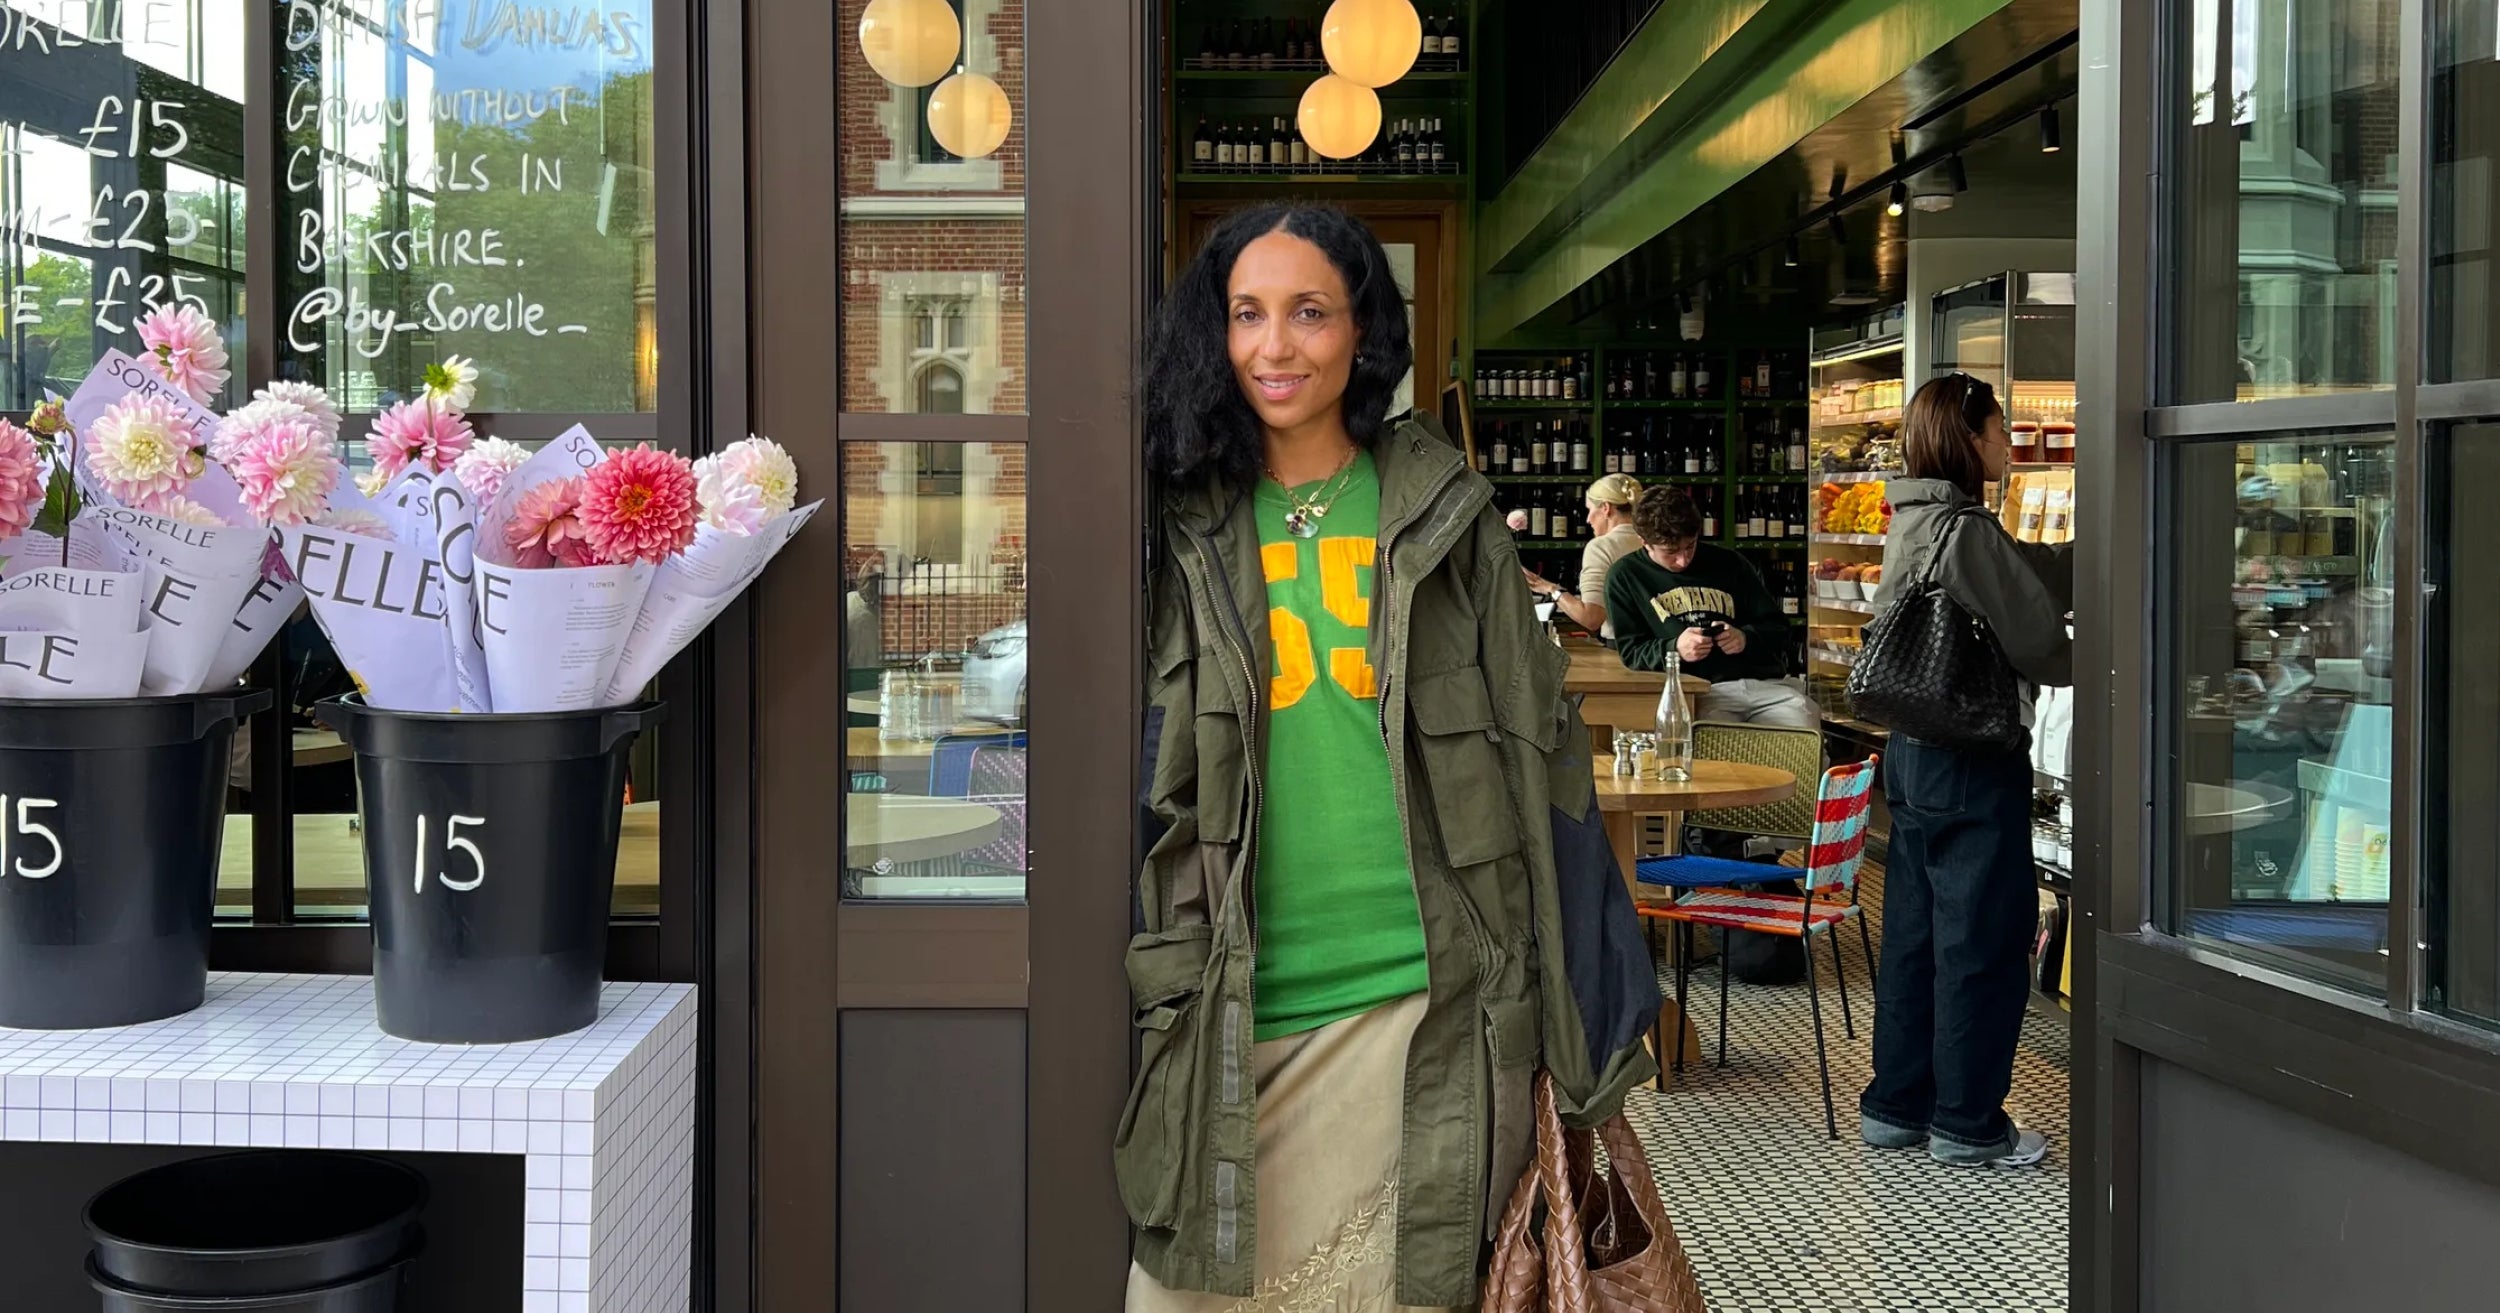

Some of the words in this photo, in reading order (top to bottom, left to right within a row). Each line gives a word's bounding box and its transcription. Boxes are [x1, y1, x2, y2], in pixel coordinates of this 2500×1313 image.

[79, 95, 188, 158] £15
[429, 85, 577, 126] WITHOUT
[520, 152, 562, 195] IN
[297, 208, 524, 274] BERKSHIRE.
[97, 507, 216, 548] SORELLE
[0, 794, 63, 879] 15
[414, 813, 486, 894] 15
